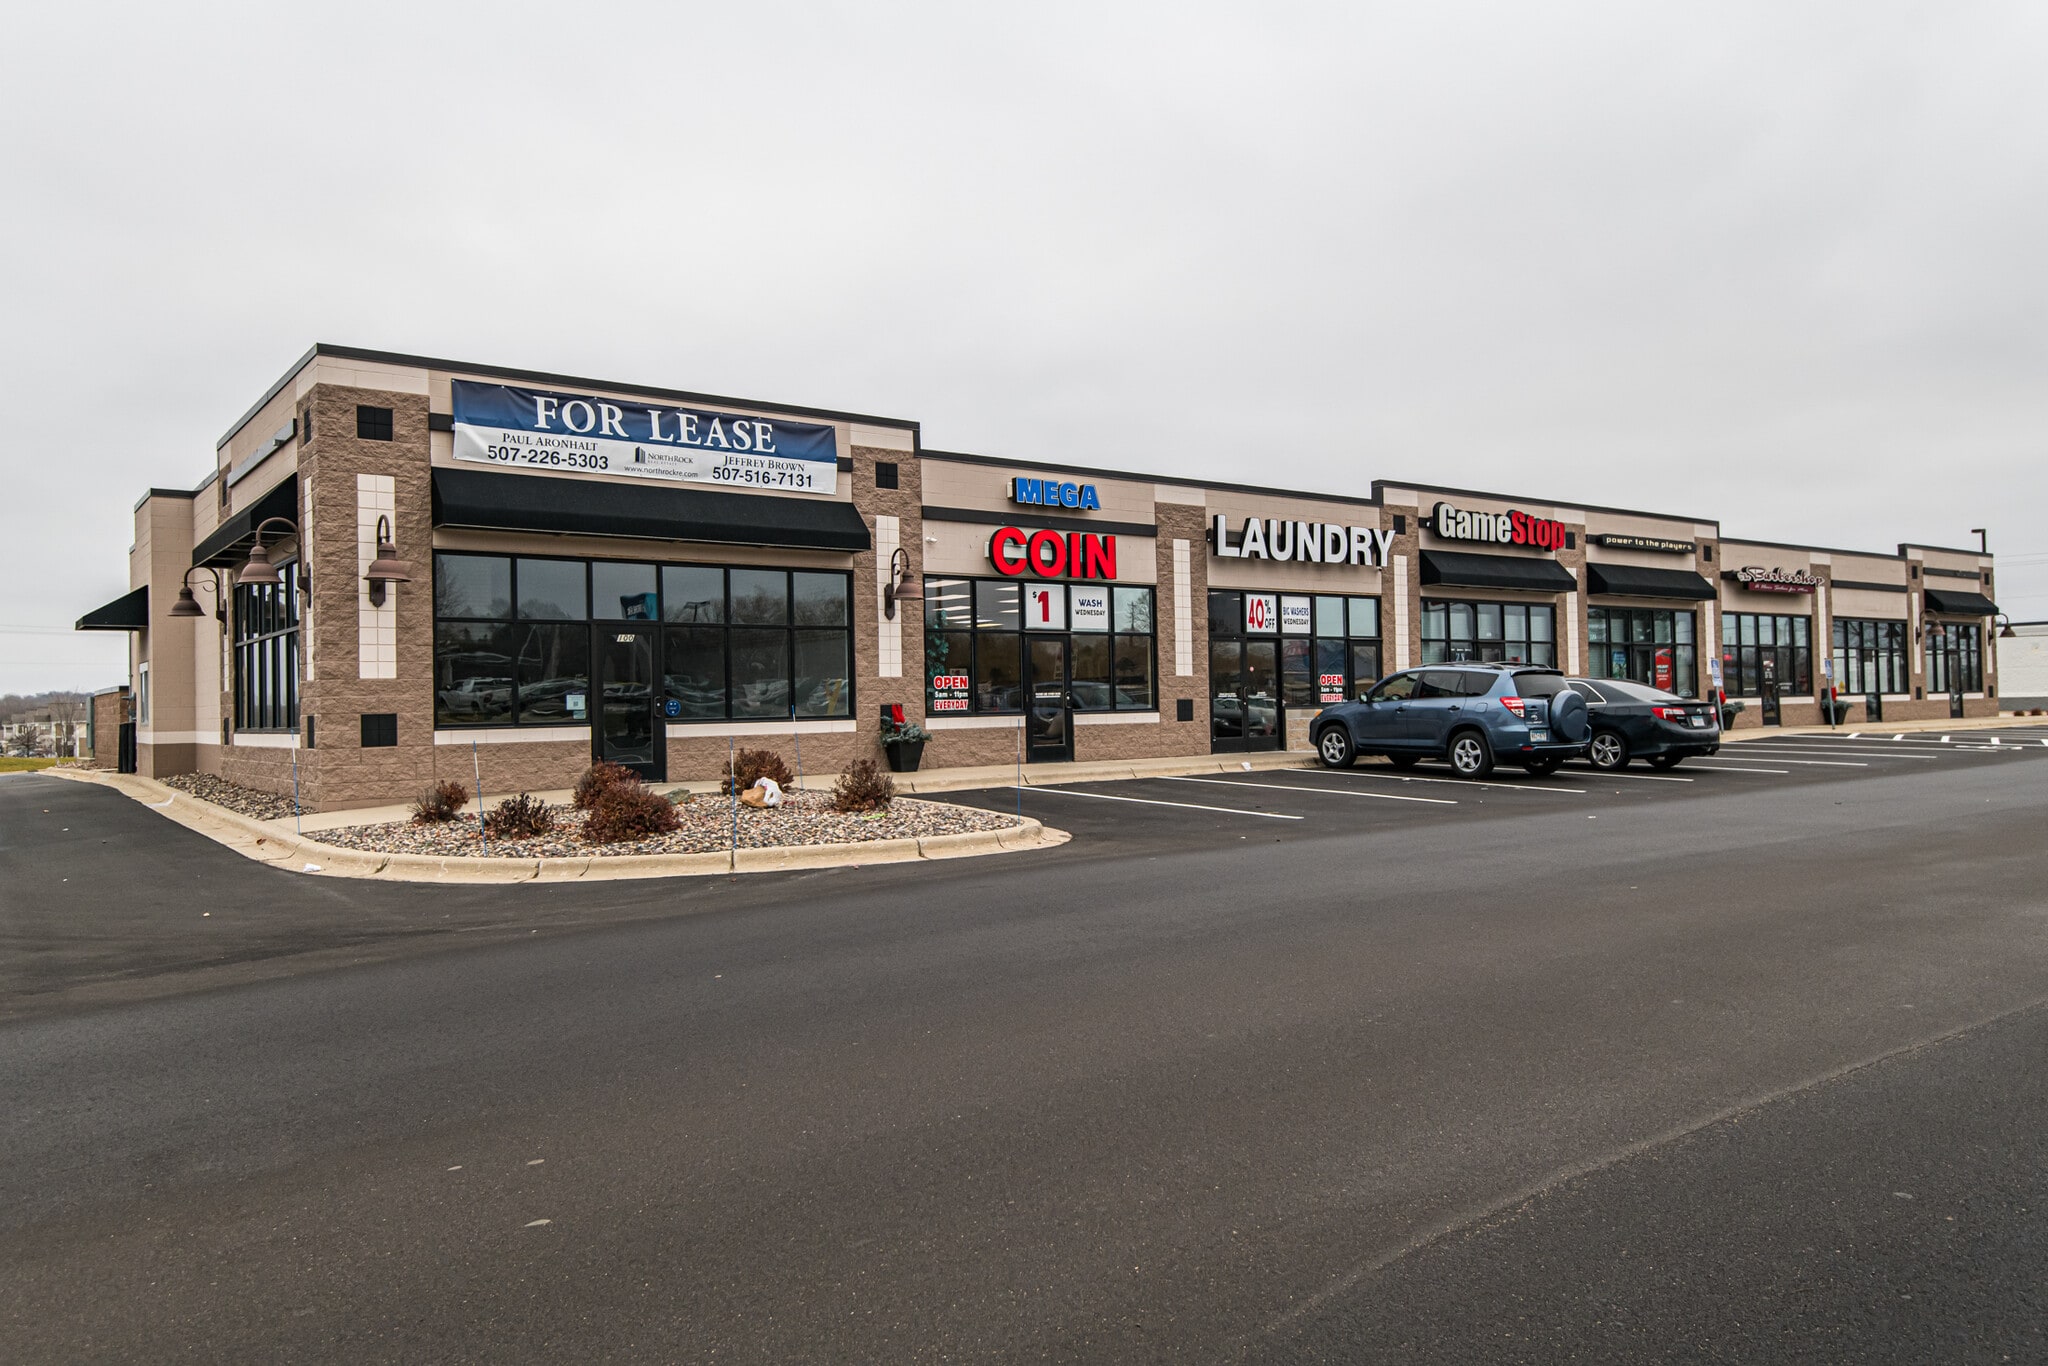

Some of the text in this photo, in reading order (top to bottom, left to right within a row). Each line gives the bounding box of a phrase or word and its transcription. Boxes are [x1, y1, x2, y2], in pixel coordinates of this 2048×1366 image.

[533, 396, 776, 453] FOR LEASE
[502, 432, 598, 452] PAUL ARONHALT
[487, 445, 609, 470] 507-226-5303
[723, 455, 805, 472] JEFFREY BROWN
[624, 466, 698, 478] www.northrockre.com
[712, 467, 812, 488] 507-516-7131
[1014, 477, 1101, 511] MEGA
[1436, 502, 1566, 551] GameStop
[1215, 514, 1396, 567] LAUNDRY
[1635, 538, 1644, 546] to
[1661, 541, 1692, 550] players
[990, 526, 1117, 580] COIN
[1747, 567, 1825, 587] Barbershop
[1078, 599, 1103, 607] WASH
[1265, 618, 1275, 629] OFF
[1283, 617, 1309, 625] WEDNESDAY
[934, 675, 969, 689] OPEN
[1320, 674, 1343, 686] OPEN
[934, 699, 968, 711] EVERYDAY
